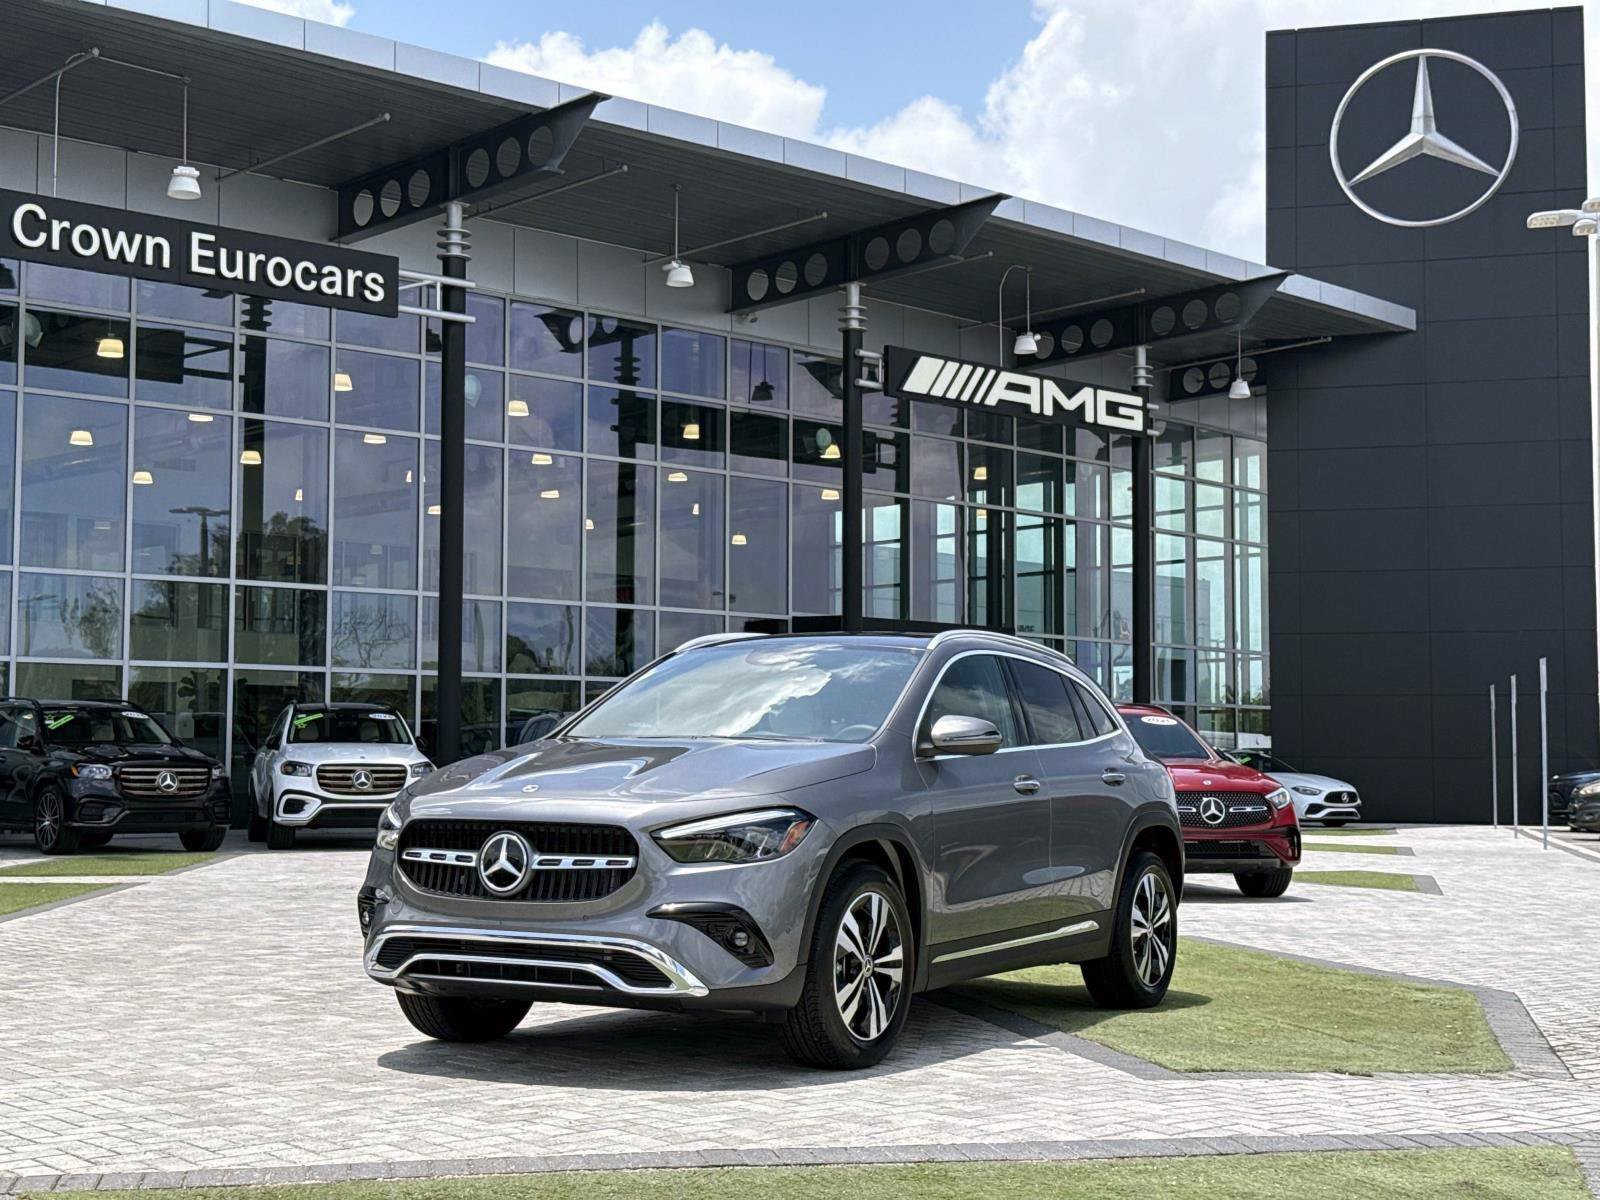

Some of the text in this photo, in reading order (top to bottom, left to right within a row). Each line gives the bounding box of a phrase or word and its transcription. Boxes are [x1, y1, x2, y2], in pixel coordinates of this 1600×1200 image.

[12, 203, 386, 302] Crown Eurocars
[984, 371, 1143, 431] AMG
